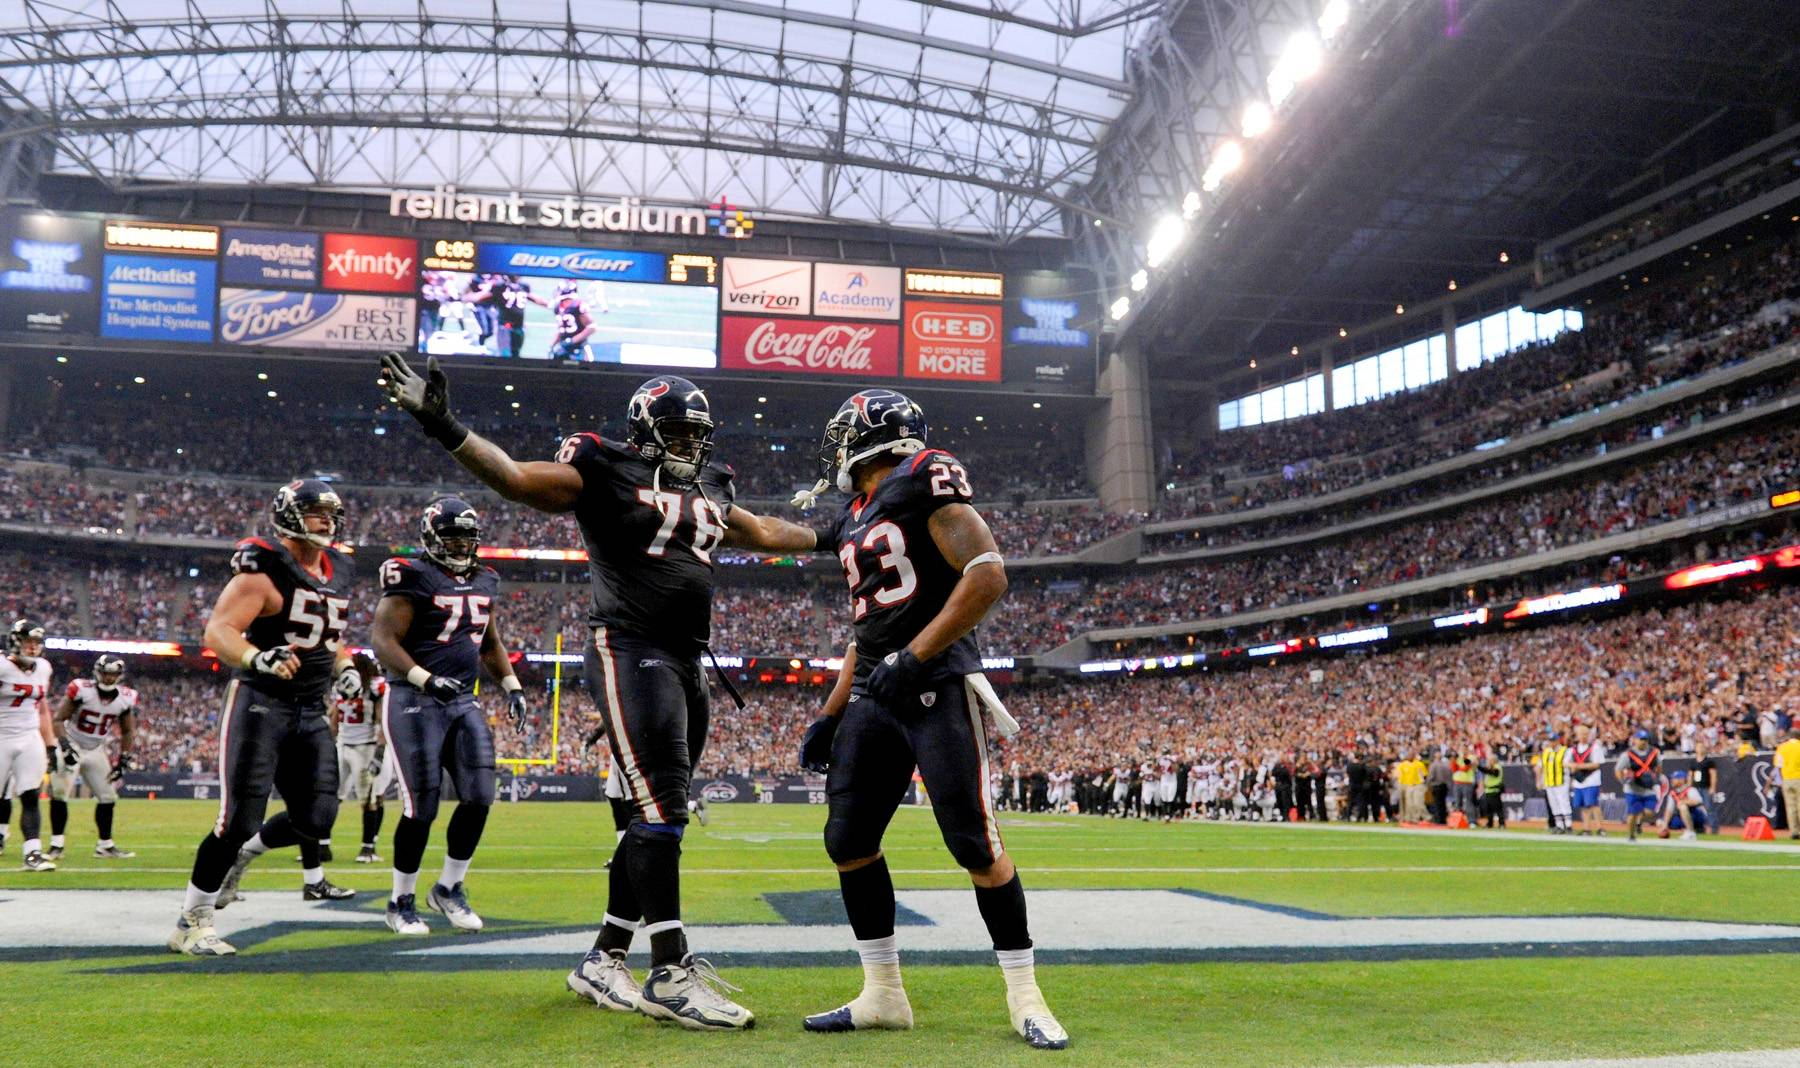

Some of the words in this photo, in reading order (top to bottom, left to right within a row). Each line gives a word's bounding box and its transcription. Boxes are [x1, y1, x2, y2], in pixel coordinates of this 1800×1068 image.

[390, 187, 526, 224] reliant
[538, 195, 706, 235] stadium
[226, 238, 316, 261] AmegyBank
[328, 249, 412, 280] xfinity
[509, 252, 561, 269] BUD
[568, 256, 635, 273] LIGHT
[109, 266, 197, 285] Methodist
[109, 300, 132, 311] The
[135, 301, 198, 315] Methodist
[385, 298, 407, 309] THE
[729, 290, 800, 310] verizon
[818, 291, 895, 312] Academy
[107, 313, 161, 329] Hospital
[162, 315, 211, 330] System
[222, 290, 315, 342] Ford
[356, 308, 407, 325] BEST
[338, 325, 407, 342] TEXAS
[920, 346, 933, 354] NO
[934, 346, 961, 355] STORE
[963, 348, 986, 356] DOES
[919, 354, 986, 375] MORE
[1036, 364, 1065, 376] reliant
[929, 463, 973, 497] 23
[636, 487, 724, 564] 76
[284, 587, 350, 652] 55
[434, 595, 491, 644] 75
[541, 785, 567, 794] PEN
[808, 791, 826, 804] 59
